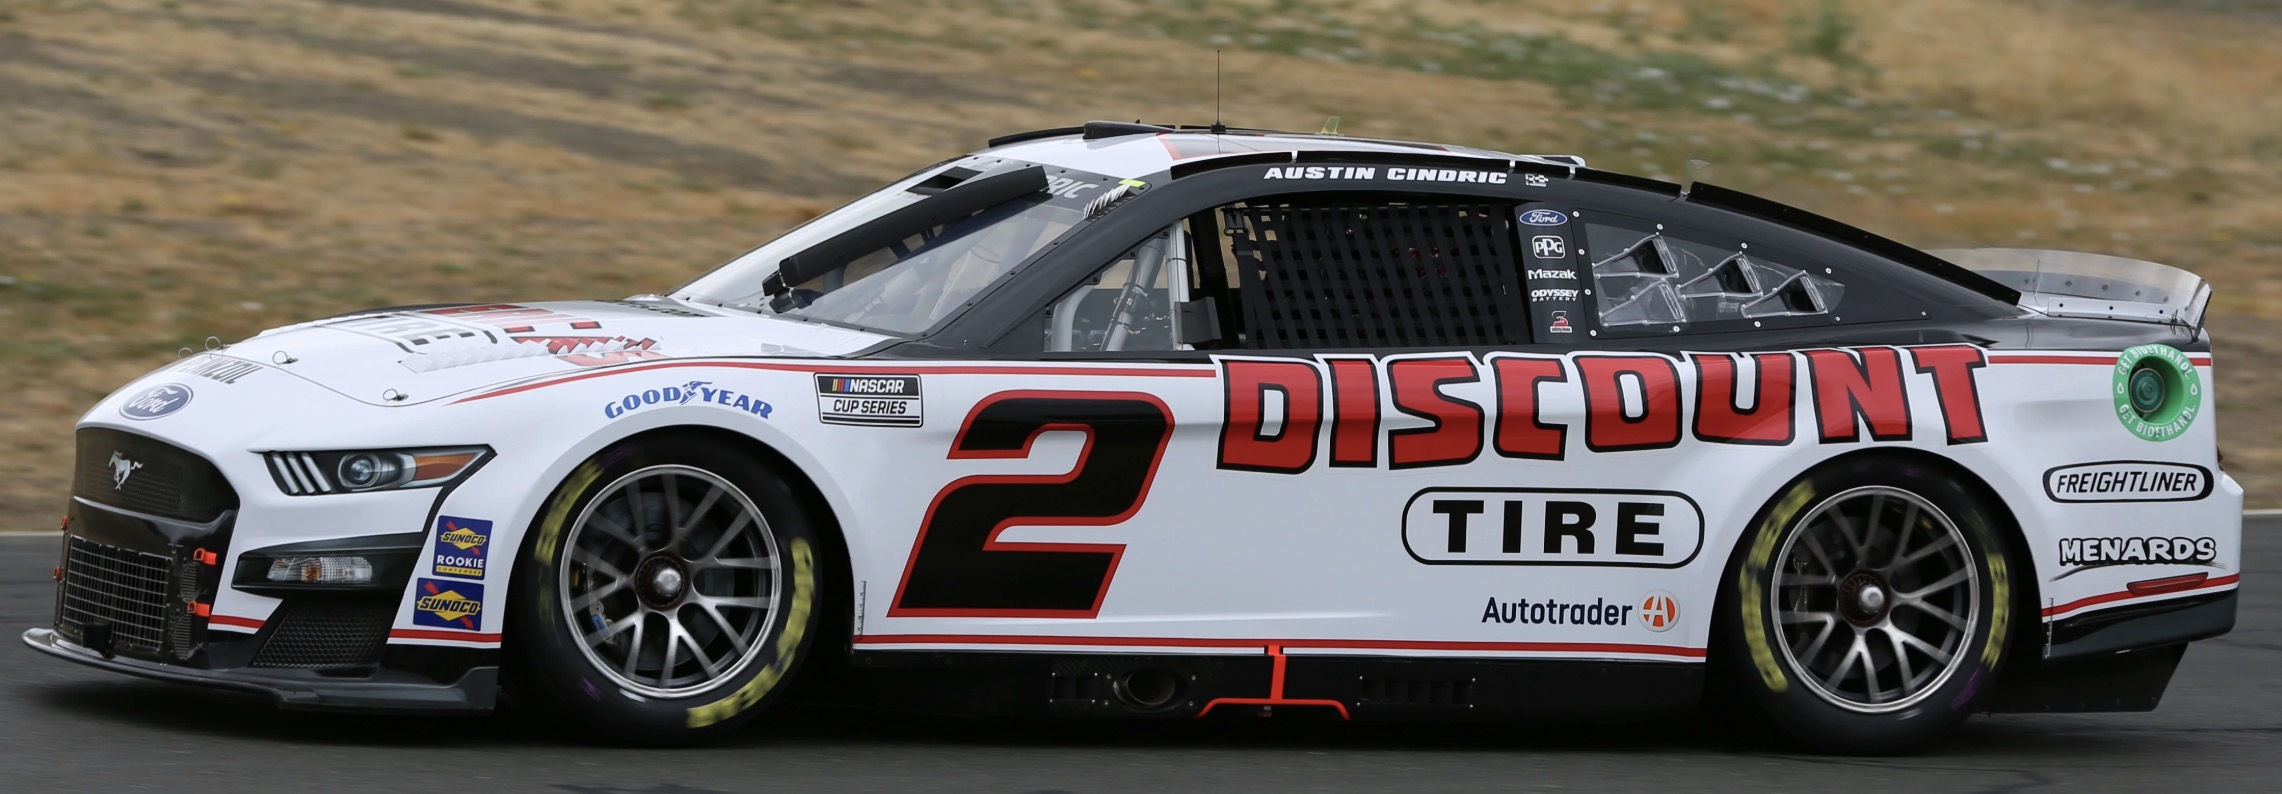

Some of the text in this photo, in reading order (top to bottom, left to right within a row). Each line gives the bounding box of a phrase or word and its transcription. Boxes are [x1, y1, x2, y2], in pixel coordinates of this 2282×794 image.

[1263, 166, 1376, 180] AUSTIN
[1386, 168, 1508, 184] CINDRIC
[1528, 211, 1559, 224] Ford
[1534, 237, 1564, 257] PPG
[1527, 268, 1578, 280] Mazak
[1530, 288, 1579, 298] ODYSSEY
[2117, 354, 2133, 376] GET
[848, 378, 905, 394] NASCAR
[128, 386, 180, 414] Ford
[832, 399, 908, 415] CUP SERIES
[1215, 345, 1990, 476] DISCOUNT
[2119, 403, 2137, 425] GET
[2056, 471, 2198, 494] FREIGHTLINER
[886, 388, 1175, 619] 2
[1432, 499, 1665, 557] TIRE
[442, 532, 486, 545] SUNOCO
[436, 554, 484, 568] ROOKIE
[2059, 536, 2217, 567] MENARDS
[419, 597, 481, 614] SUNOCO
[1481, 596, 1633, 626] Autotrader
